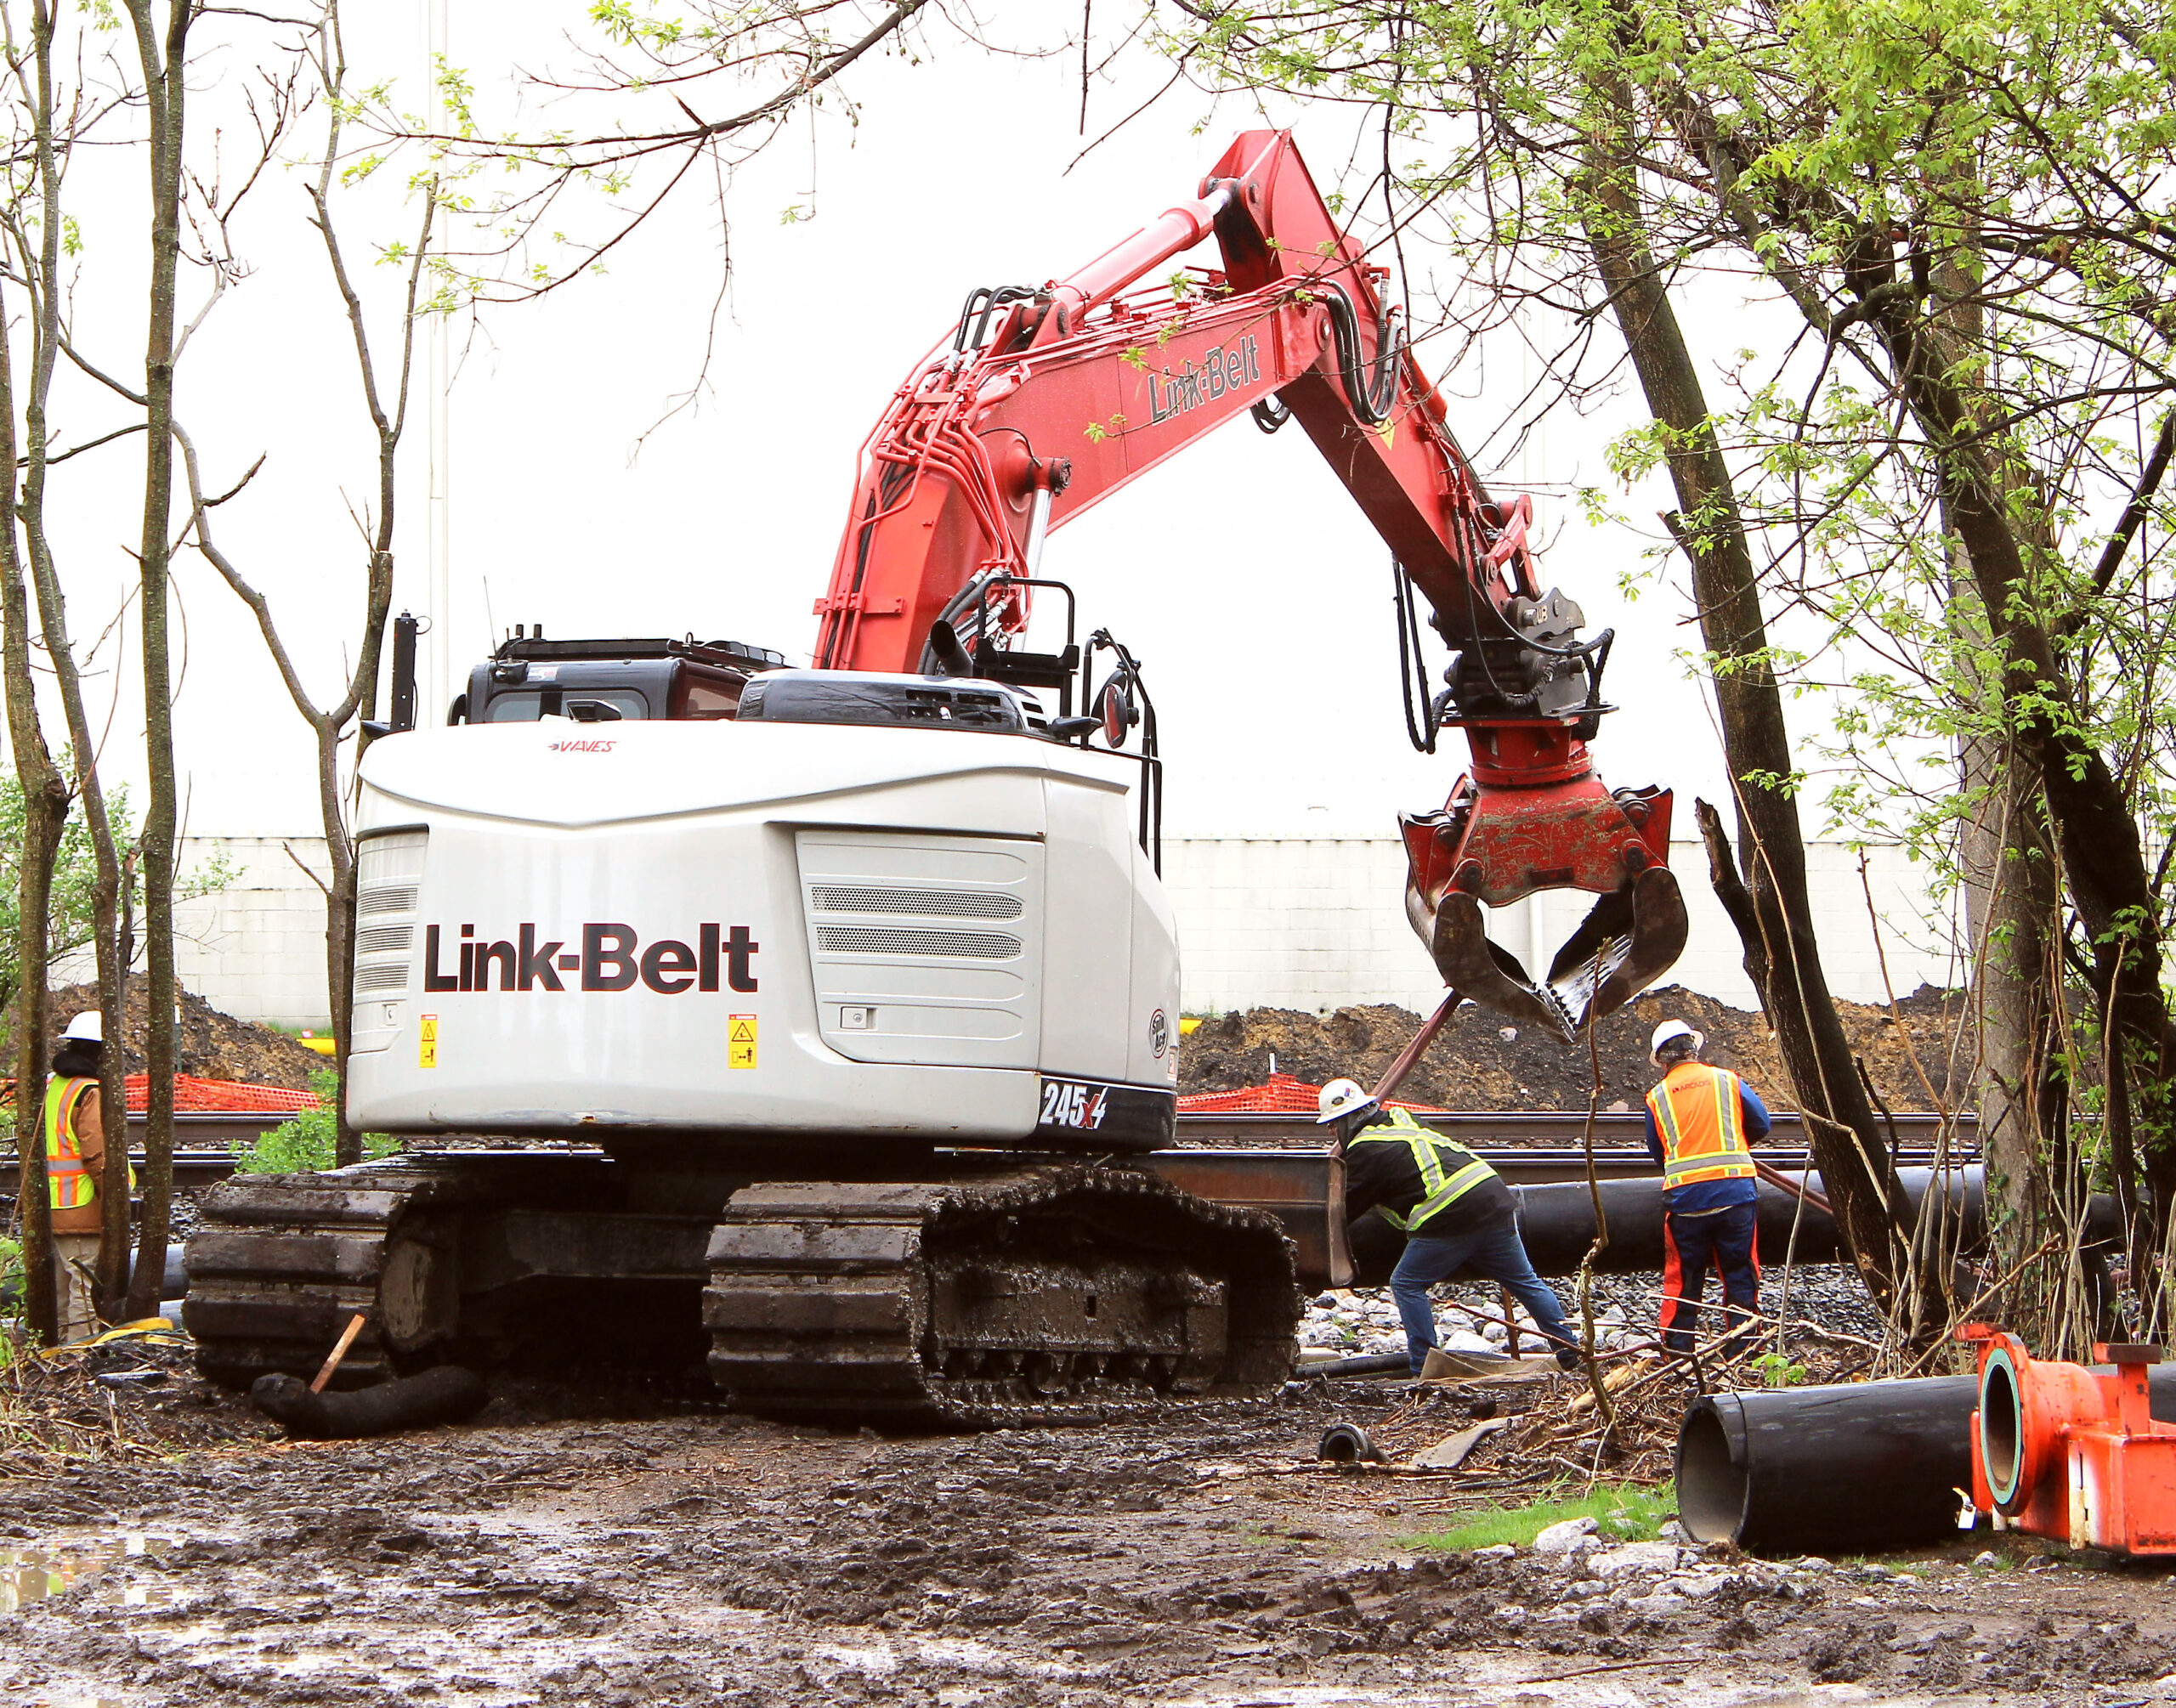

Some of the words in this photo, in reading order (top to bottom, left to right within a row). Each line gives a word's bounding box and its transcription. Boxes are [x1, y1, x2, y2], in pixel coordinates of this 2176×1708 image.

[1148, 334, 1260, 427] Link-Belt
[560, 740, 617, 752] WAVES
[424, 923, 759, 994] Link-Belt
